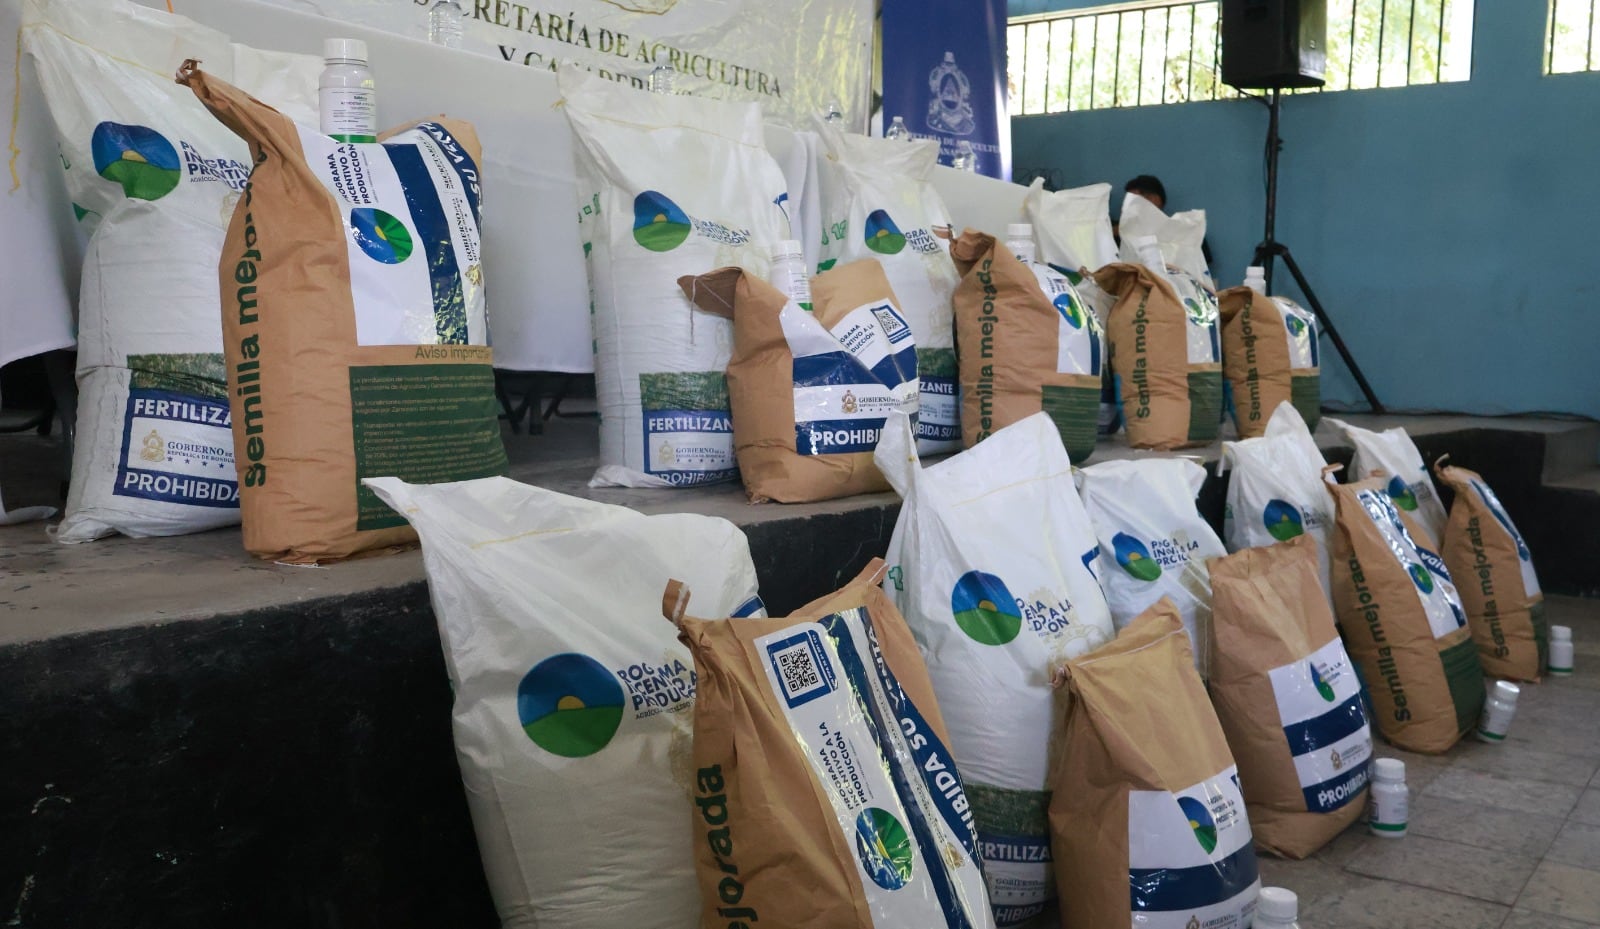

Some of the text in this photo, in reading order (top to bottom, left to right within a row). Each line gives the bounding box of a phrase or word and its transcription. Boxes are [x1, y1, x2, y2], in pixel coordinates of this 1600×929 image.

[599, 27, 629, 58] DE
[415, 345, 448, 359] Aviso
[237, 332, 266, 488] Semilla
[168, 441, 225, 456] GOBIERNO
[819, 721, 830, 737] LA
[899, 717, 928, 751] SU
[826, 738, 834, 747] A
[834, 730, 868, 804] PRODUCCIÓN
